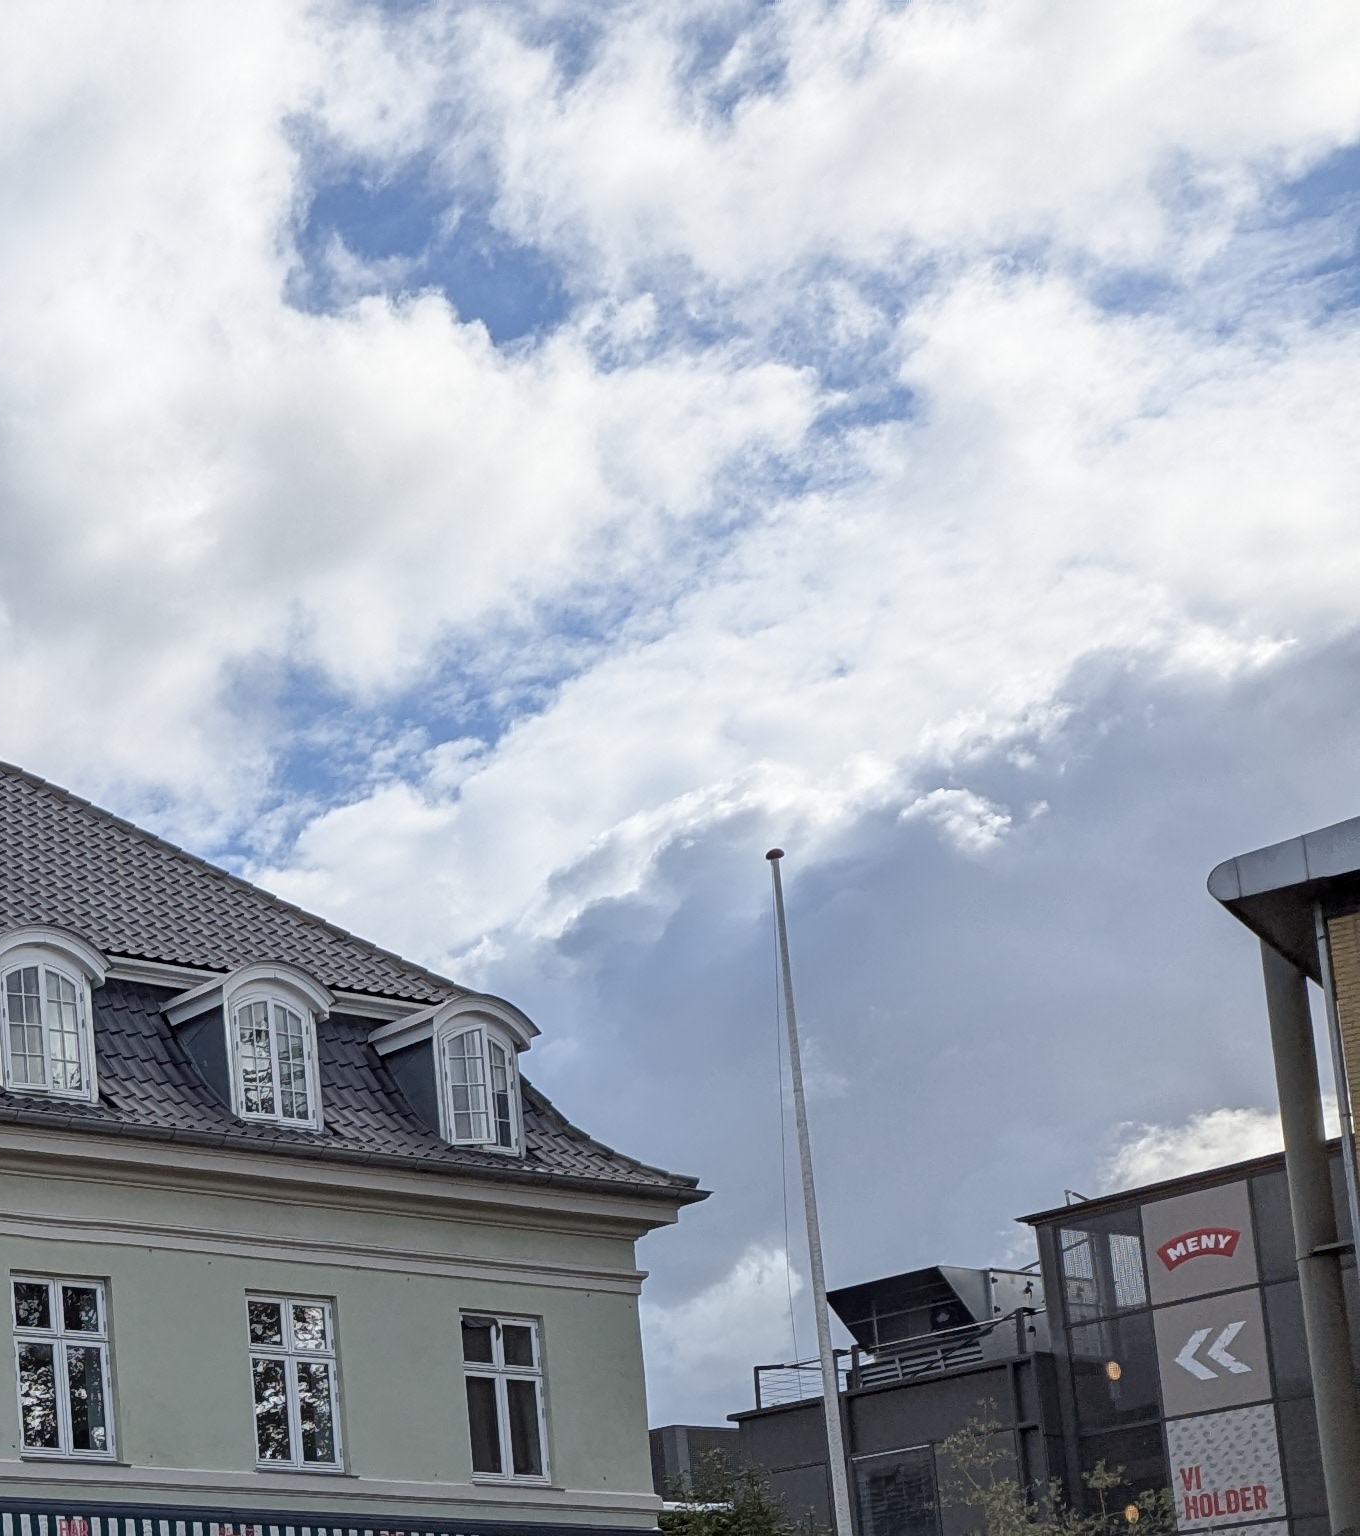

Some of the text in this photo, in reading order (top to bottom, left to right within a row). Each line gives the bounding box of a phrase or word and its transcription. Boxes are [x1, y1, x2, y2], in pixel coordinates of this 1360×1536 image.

[1166, 1233, 1233, 1262] MENY
[1179, 1465, 1202, 1491] VI
[1183, 1484, 1268, 1520] HOLDER
